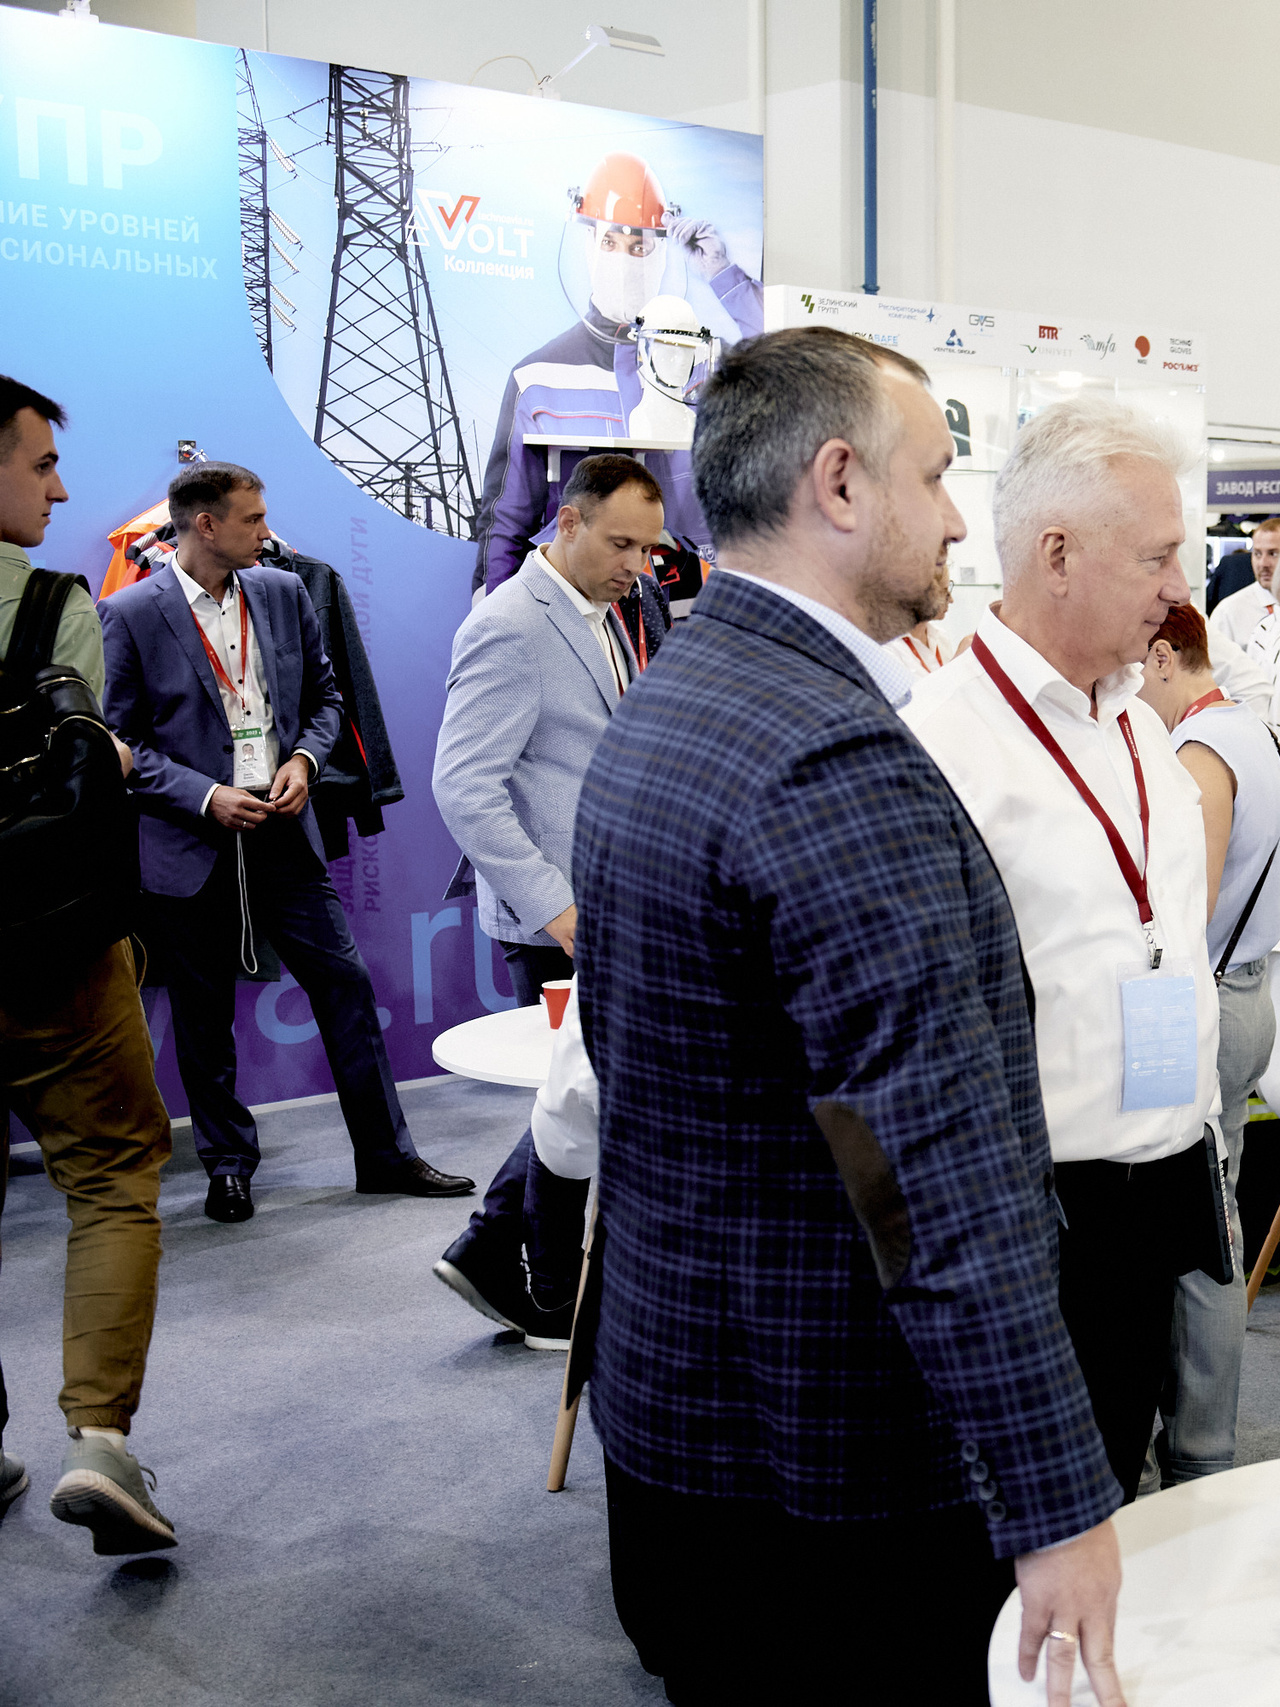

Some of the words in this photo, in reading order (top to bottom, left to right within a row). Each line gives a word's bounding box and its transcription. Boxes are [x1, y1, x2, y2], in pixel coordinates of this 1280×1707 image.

[0, 94, 163, 190] ПР
[59, 206, 199, 244] УРОВНЕЙ
[0, 237, 218, 280] СИОНАЛЬНЫХ
[444, 255, 534, 280] Коллекция
[819, 298, 858, 309] ЗЕЛИНСКИЙ
[969, 314, 995, 328] GVS
[1038, 325, 1058, 341] BTR
[1216, 481, 1254, 497] ЗАВОД
[350, 517, 374, 586] ДУГИ
[362, 834, 381, 913] РИСКО
